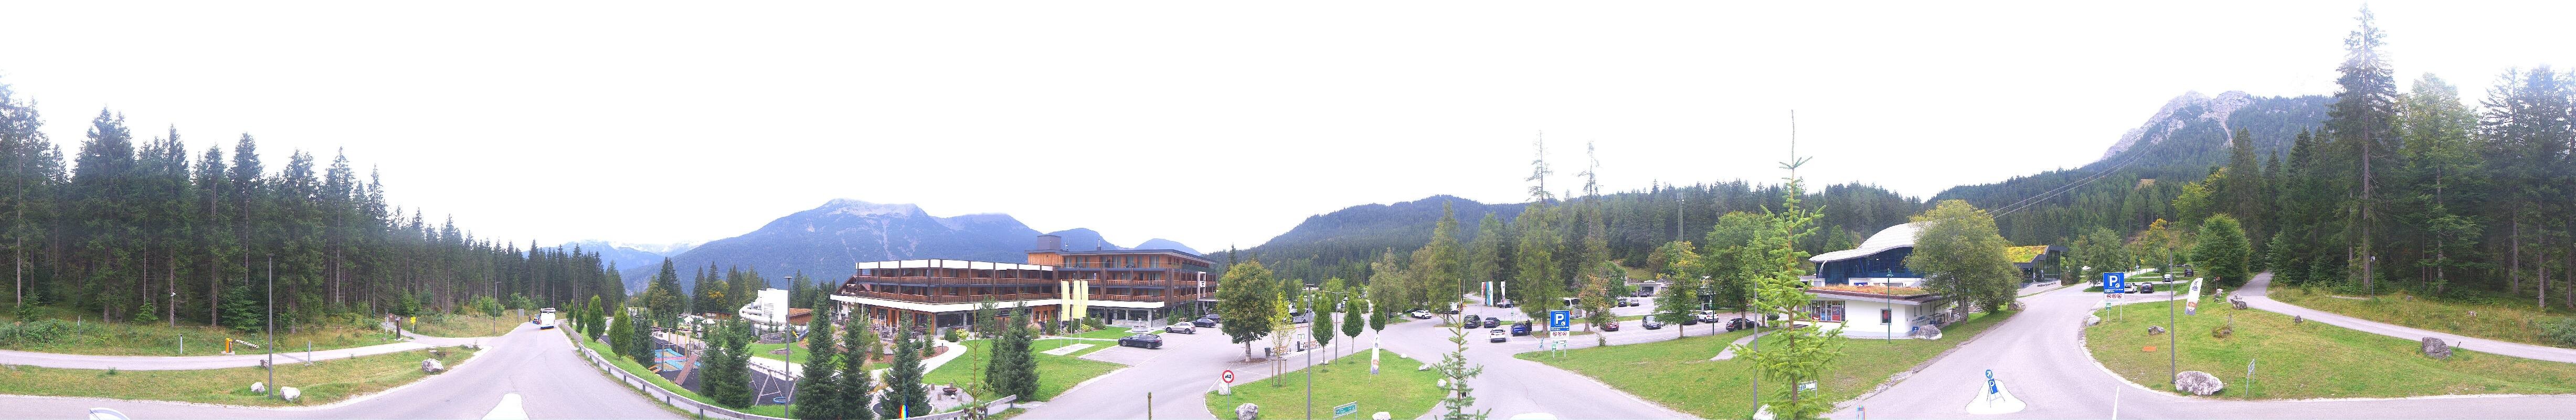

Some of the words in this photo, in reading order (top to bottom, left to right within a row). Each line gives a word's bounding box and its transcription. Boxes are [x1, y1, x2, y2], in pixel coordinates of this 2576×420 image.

[2109, 275, 2118, 287] P
[1555, 313, 1564, 324] P
[1989, 380, 1995, 394] P
